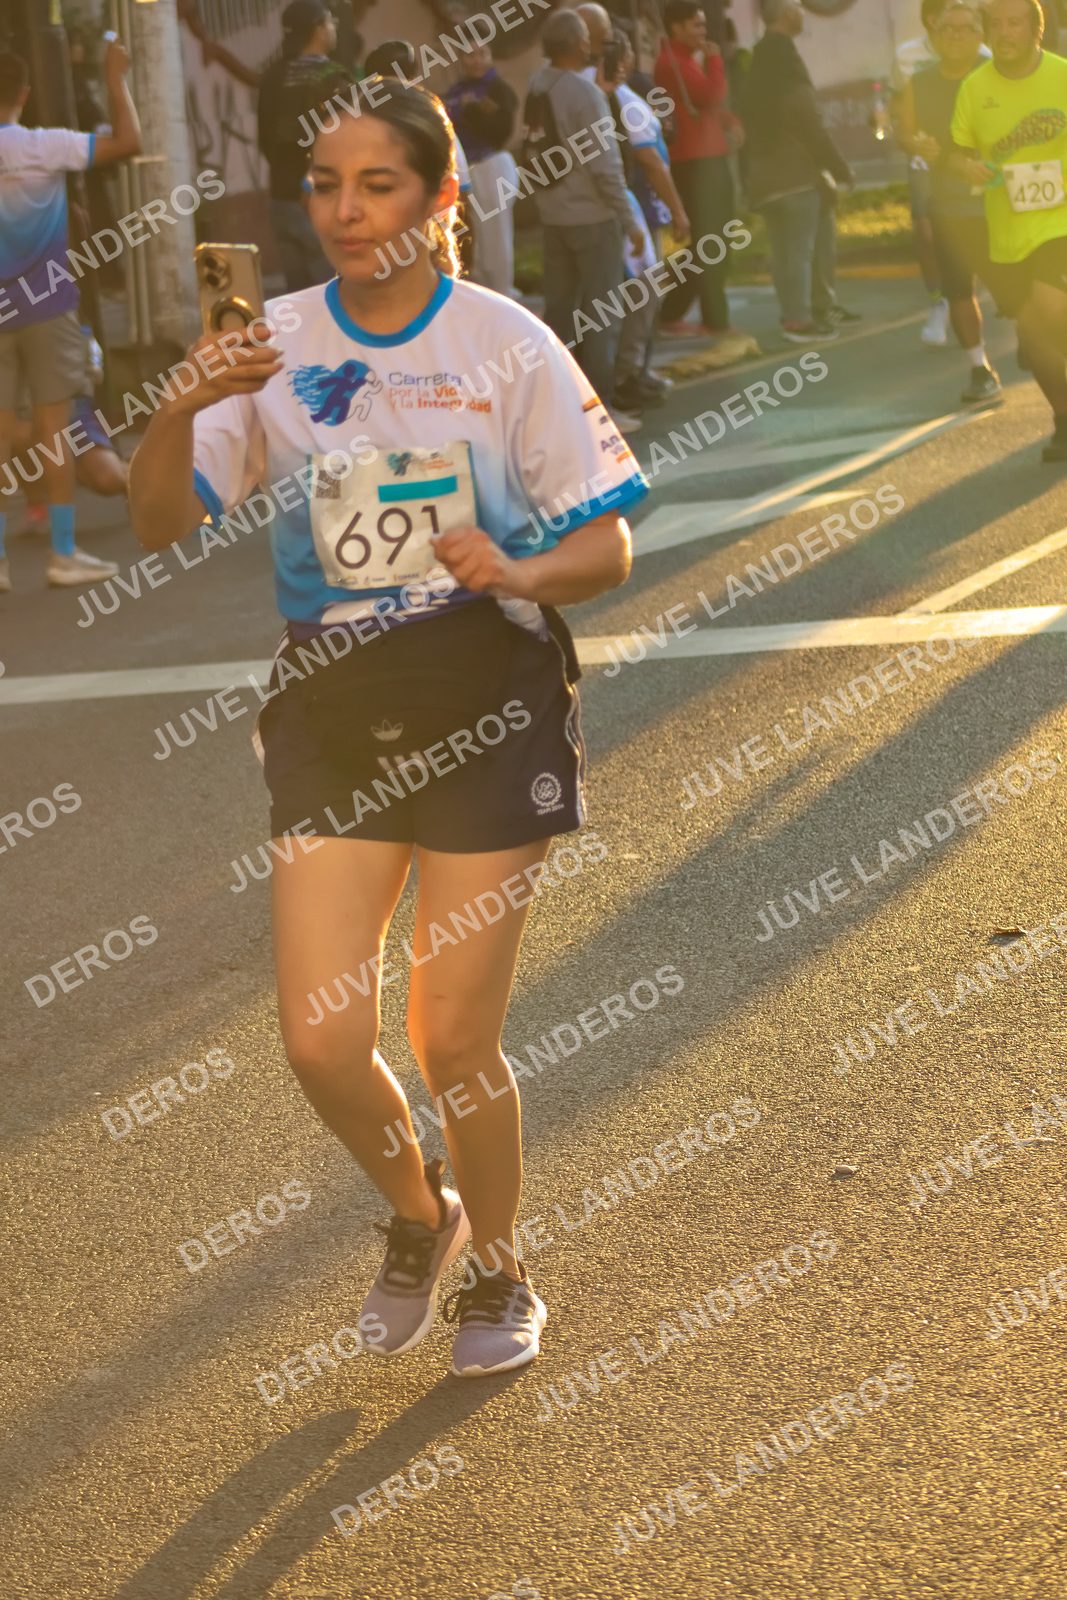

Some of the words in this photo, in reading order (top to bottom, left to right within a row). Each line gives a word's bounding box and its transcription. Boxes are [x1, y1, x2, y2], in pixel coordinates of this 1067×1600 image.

[1014, 181, 1056, 204] 420
[418, 398, 492, 413] Integdad
[335, 505, 440, 569] 691
